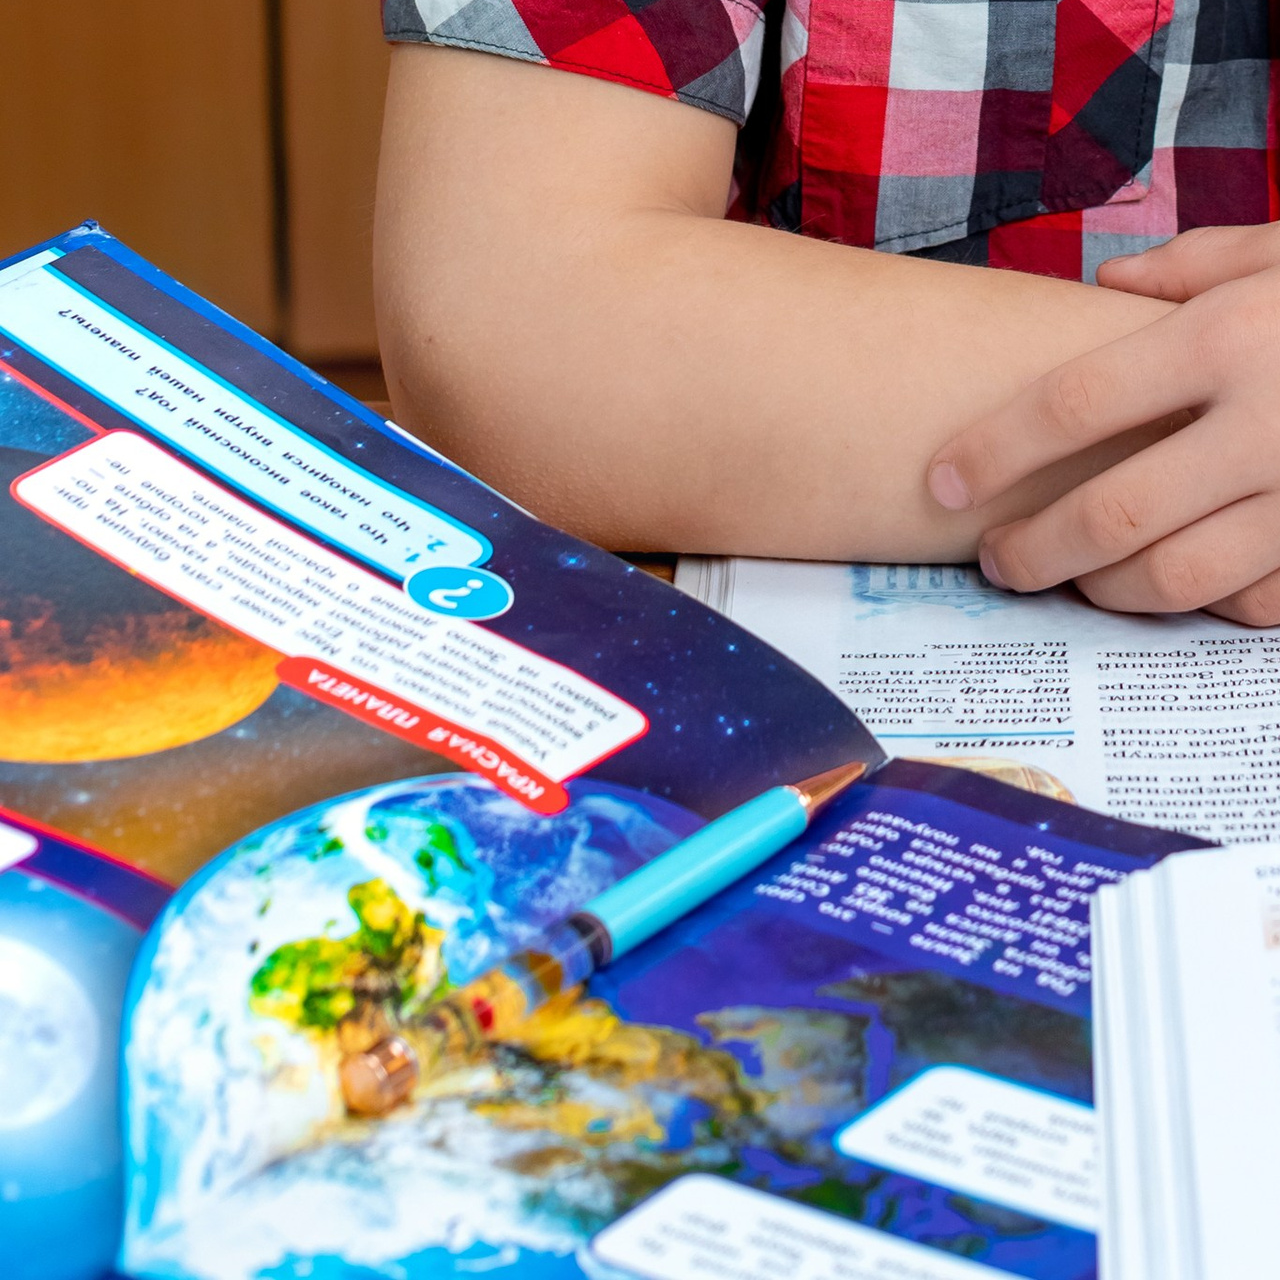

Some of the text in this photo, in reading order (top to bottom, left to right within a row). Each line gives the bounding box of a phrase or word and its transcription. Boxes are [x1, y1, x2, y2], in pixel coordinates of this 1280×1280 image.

[133, 383, 180, 416] год?
[57, 306, 449, 556] 2. Что находится внутри нашей планеты?
[105, 458, 132, 477] пе-
[183, 416, 292, 489] високосный
[52, 486, 90, 512] при-
[70, 476, 99, 496] по-
[103, 498, 131, 518] На
[113, 483, 173, 523] орбите
[141, 480, 211, 527] которые
[191, 490, 259, 536] планете.
[298, 486, 350, 523] такое
[95, 513, 172, 564] будущим
[137, 518, 210, 565] изучают.
[176, 523, 200, 540] на
[203, 539, 220, 550] а
[356, 521, 392, 546] Что
[222, 529, 291, 573] станций,
[266, 537, 339, 580] красной
[177, 562, 225, 593] стать
[214, 565, 304, 618] тщательно
[228, 550, 322, 608] марсоходы,
[228, 593, 289, 628] может
[369, 595, 436, 630] данные
[295, 627, 343, 658] Марс
[312, 619, 345, 640] Его
[327, 609, 411, 652] работают
[445, 630, 507, 666] Землю
[923, 642, 1035, 650] колоннах.
[1097, 651, 1197, 659] бронзы.
[1206, 649, 1252, 657] или
[923, 668, 1069, 676] изображение
[953, 659, 1038, 667] здания.
[1097, 658, 1243, 671] состязаний
[1137, 671, 1214, 680] Зевса.
[839, 678, 998, 686] скульптурное
[985, 707, 1072, 715] шенная
[309, 668, 543, 802] КРАСНАЯ ПЛАНЕТА
[934, 739, 1075, 749] Словарик
[867, 813, 959, 846] получаем
[902, 851, 975, 883] четыре
[910, 838, 1045, 891] прибавляется
[970, 843, 1001, 861] мы
[856, 866, 937, 902] больше
[869, 855, 953, 893] Именно
[819, 902, 856, 921] это
[945, 913, 1021, 943] длится
[993, 959, 1022, 977] на
